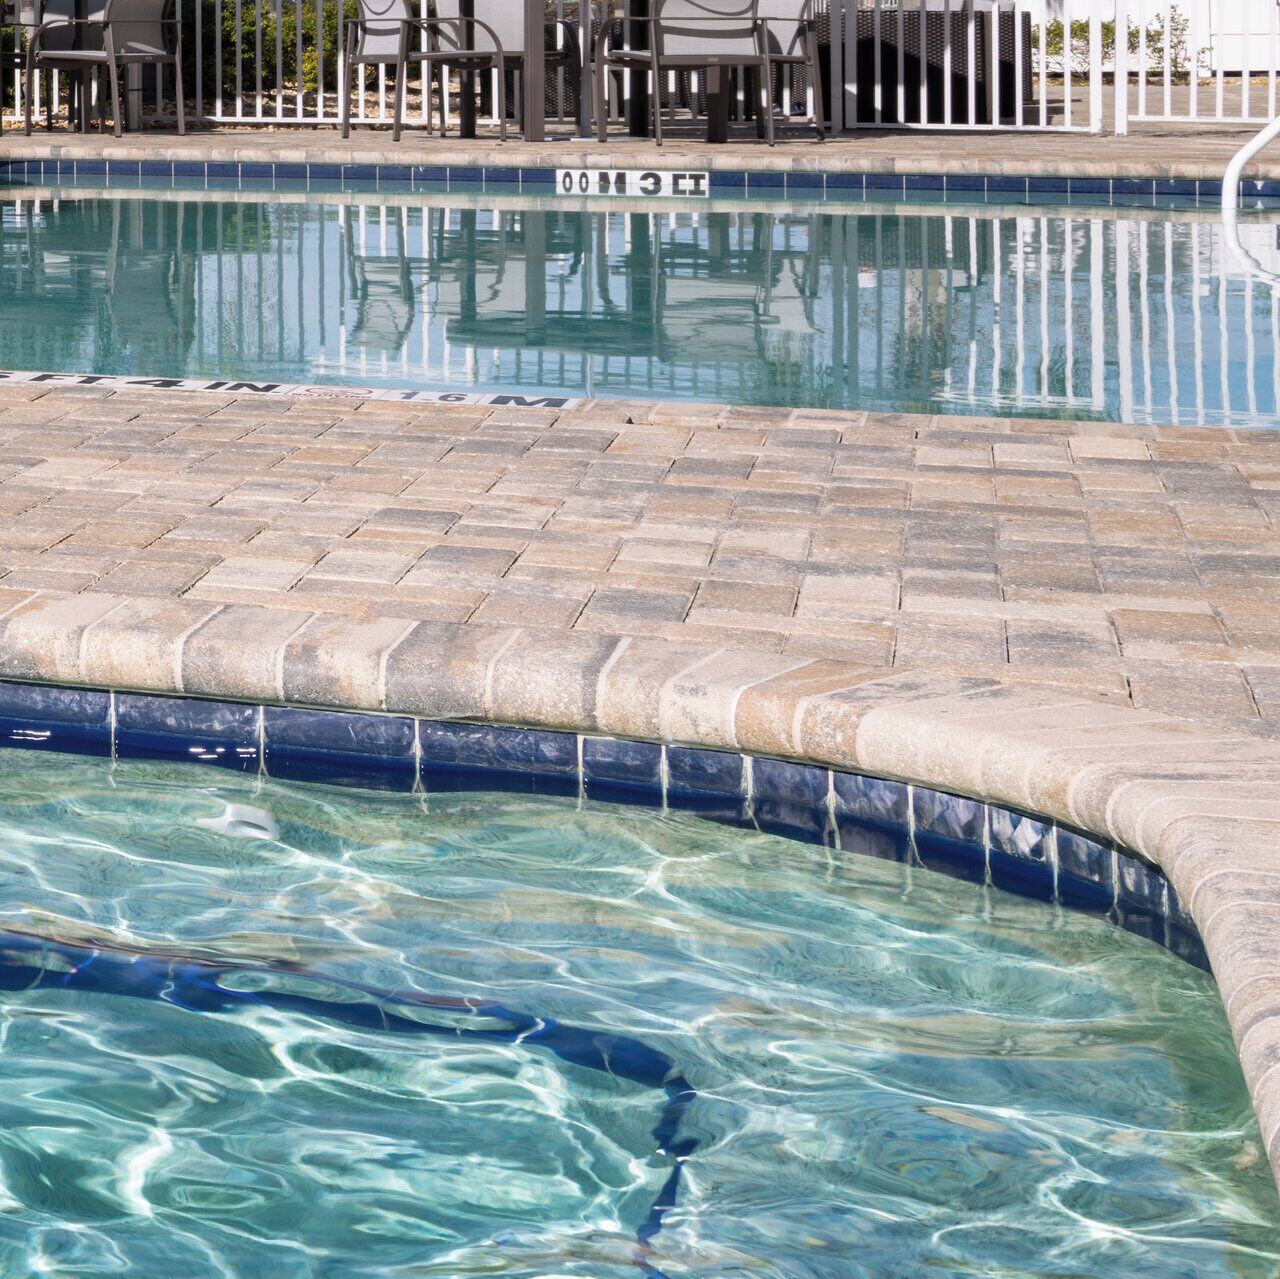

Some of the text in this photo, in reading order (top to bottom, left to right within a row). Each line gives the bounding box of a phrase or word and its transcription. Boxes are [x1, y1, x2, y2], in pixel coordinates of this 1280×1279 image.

[125, 379, 184, 388] 4
[400, 391, 569, 408] 1.6 M
